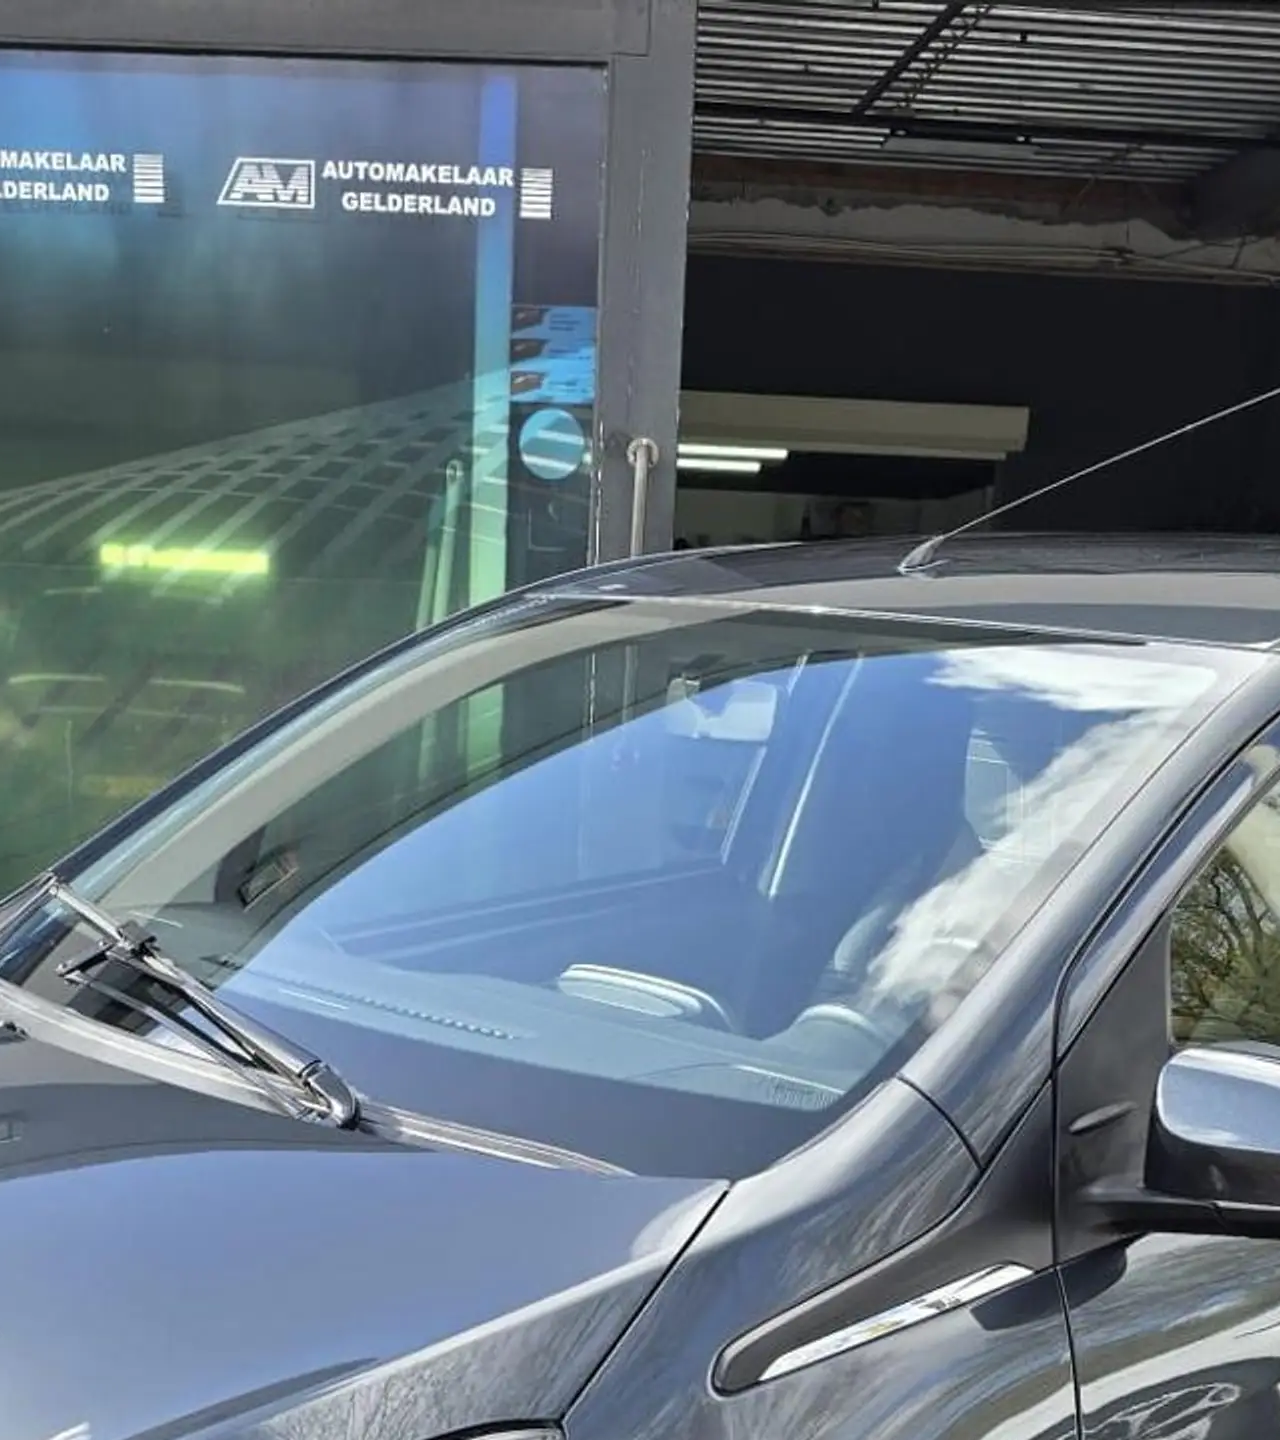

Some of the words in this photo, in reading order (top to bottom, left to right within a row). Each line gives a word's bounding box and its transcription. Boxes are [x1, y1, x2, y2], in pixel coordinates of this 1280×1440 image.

[228, 161, 311, 201] AM
[320, 159, 515, 188] AUTOMAKELAAR
[341, 191, 497, 217] GELDERLAND
